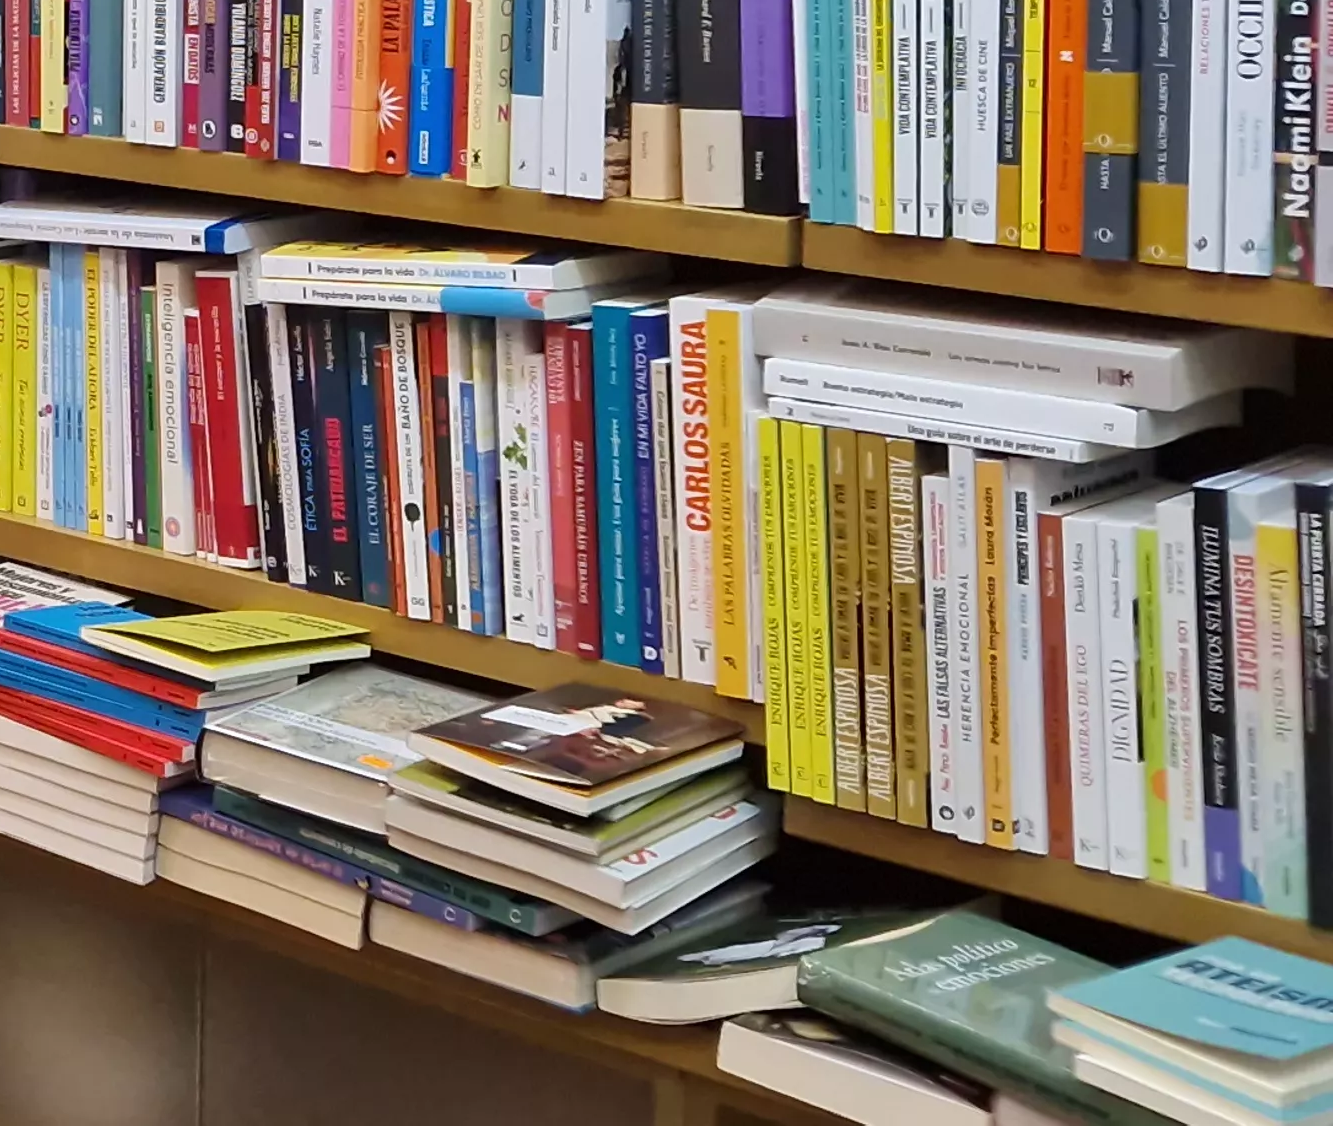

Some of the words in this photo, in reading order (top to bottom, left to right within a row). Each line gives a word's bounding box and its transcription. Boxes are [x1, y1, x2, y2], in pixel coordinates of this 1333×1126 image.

[382, 37, 401, 55] LA
[898, 35, 912, 111] CONTEMPLATIVA
[979, 39, 989, 66] CINE
[979, 67, 988, 84] DE
[1282, 34, 1312, 113] Klein
[898, 111, 912, 136] VIDA
[978, 87, 988, 132] HUESCA
[1282, 117, 1312, 218] Naomi
[316, 264, 360, 277] Prepárate
[361, 266, 385, 278] para
[395, 265, 415, 277] vida
[15, 291, 30, 352] DYER
[160, 282, 178, 375] Inteligencia
[394, 321, 407, 374] BOSQUE
[396, 375, 409, 393] DE
[678, 319, 709, 417] SAURA
[163, 377, 179, 464] emocional
[397, 393, 410, 430] BAÑO
[682, 421, 712, 534] CARLOS
[1201, 524, 1222, 596] ILUMINA
[766, 617, 781, 668] ROJAS
[957, 573, 971, 664] EMOCIONAL
[1204, 600, 1223, 632] TUS
[767, 671, 783, 727] ENRIQUE
[833, 667, 861, 731] ESPINOSA
[960, 665, 974, 743] HERENCIA
[1205, 633, 1226, 714] SOMBRAS
[1108, 658, 1131, 763] DIGNIDAD
[836, 732, 861, 794] ALBERT
